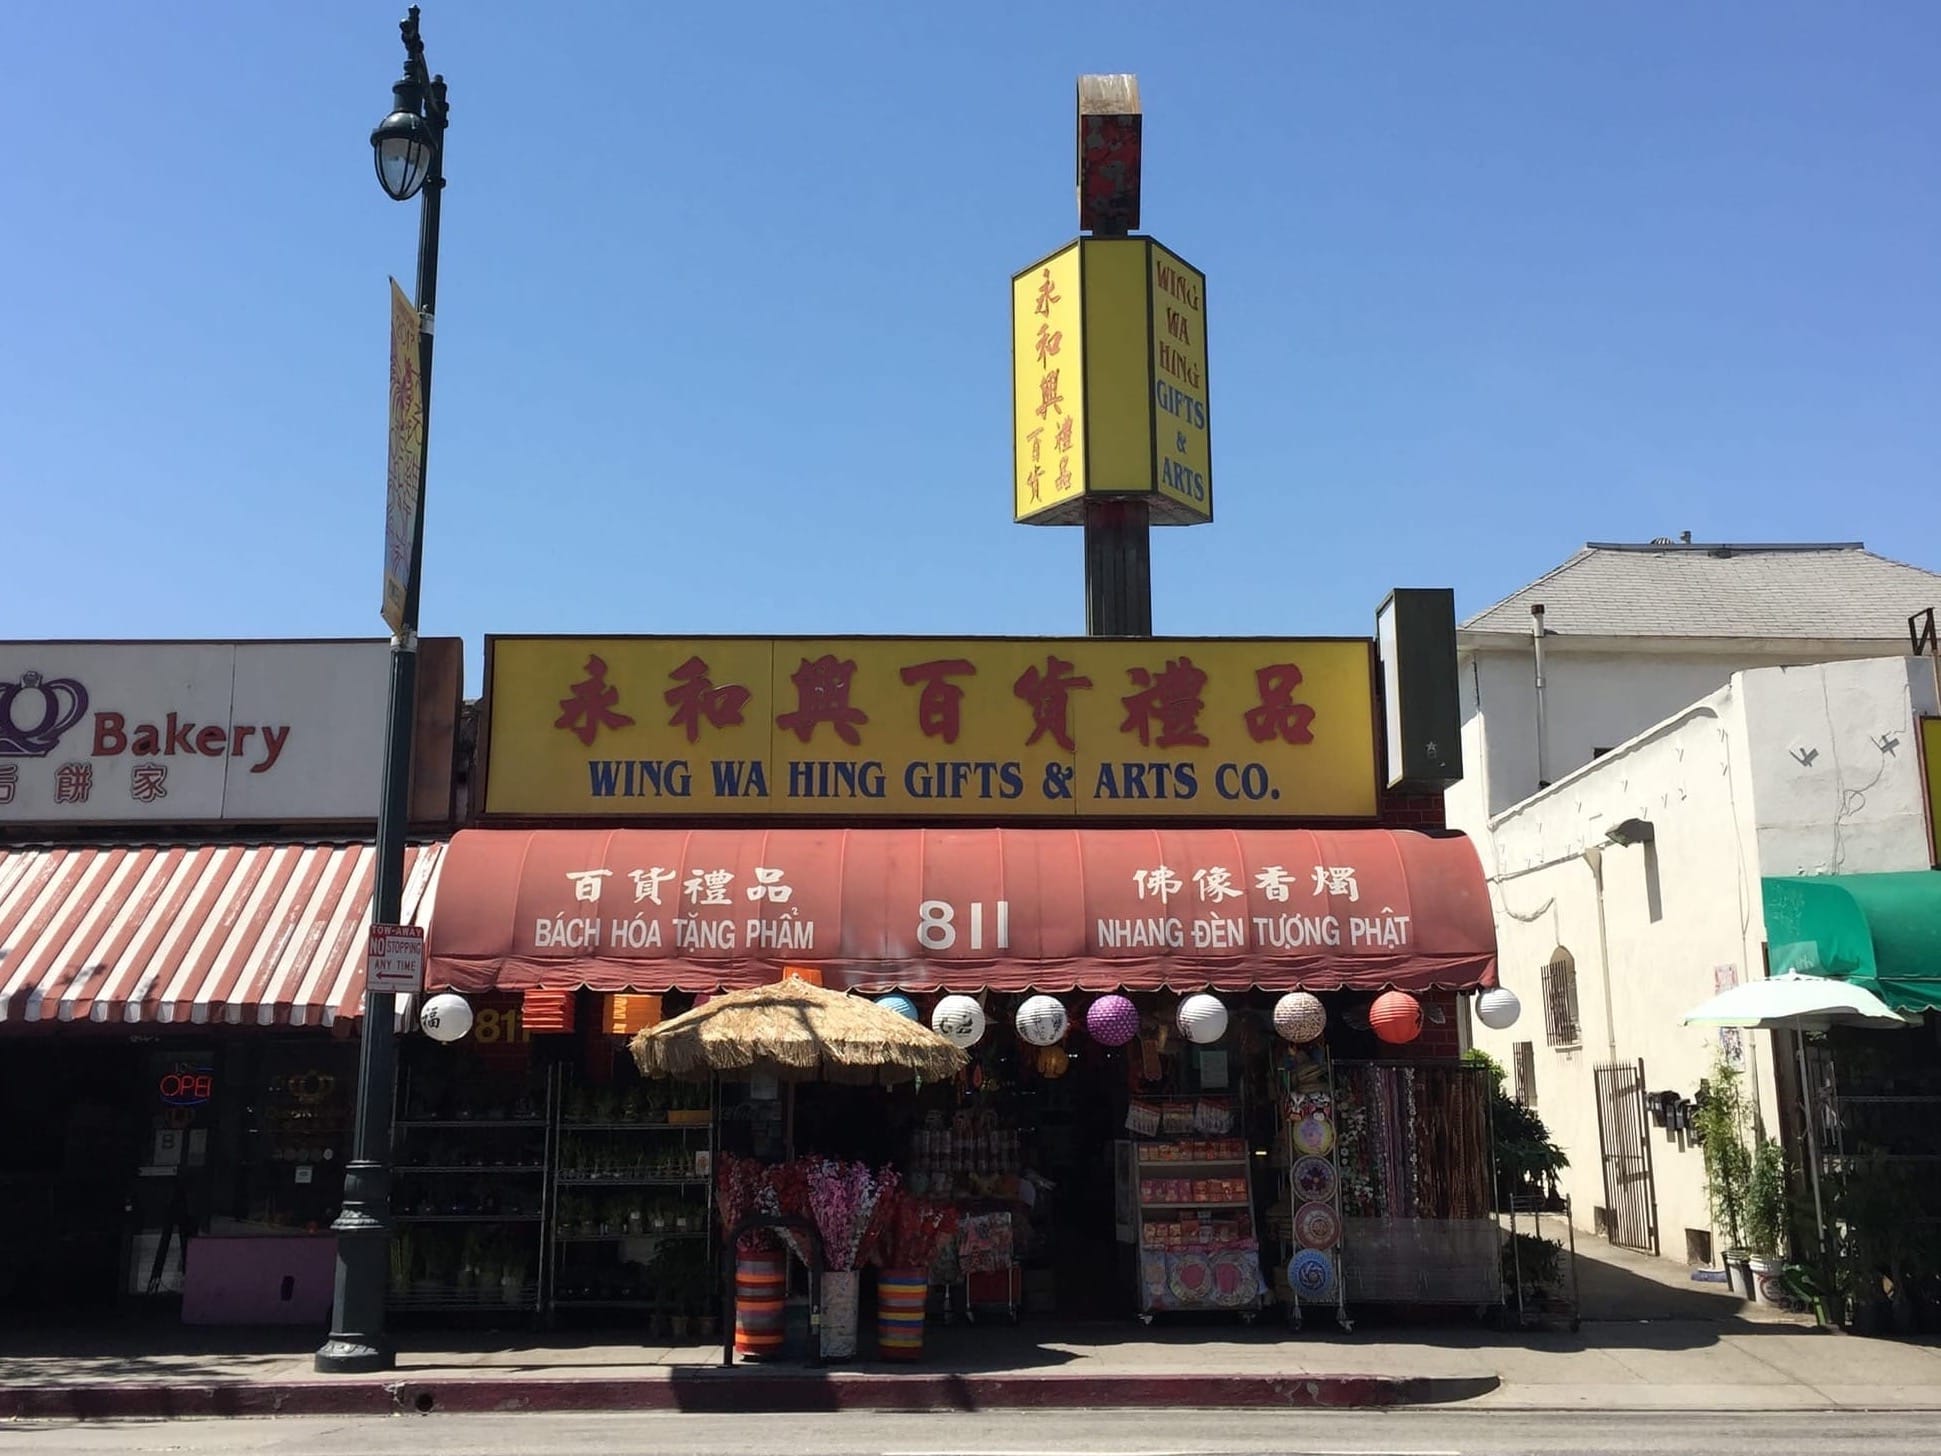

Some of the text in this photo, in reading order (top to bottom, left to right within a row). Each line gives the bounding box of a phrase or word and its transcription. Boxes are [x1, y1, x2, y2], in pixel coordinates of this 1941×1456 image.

[1157, 261, 1199, 311] WING
[1035, 268, 1064, 420] 永和興
[1167, 306, 1190, 345] WA
[1159, 341, 1200, 389] HING
[1157, 380, 1205, 430] GIFTS
[1176, 431, 1187, 454] &
[1162, 456, 1204, 502] ARTS
[553, 654, 1316, 752] 永和興百貨禮品
[91, 712, 291, 773] Bakery
[588, 760, 1281, 800] WING WA HING GIFTS & ARTS CO.
[565, 867, 794, 905] 百貨禮品
[1132, 865, 1360, 904] 佛像香燭
[371, 925, 422, 937] TOW-AWAY
[534, 911, 600, 948] BÁCH
[610, 911, 662, 948] HÓA
[916, 900, 1009, 951] 811
[1097, 915, 1184, 948] NHANG
[1191, 911, 1244, 948] ĐÈN
[1350, 907, 1410, 950] PHẬT
[369, 937, 421, 956] NO STOPPING
[375, 960, 416, 971] ANY TIME
